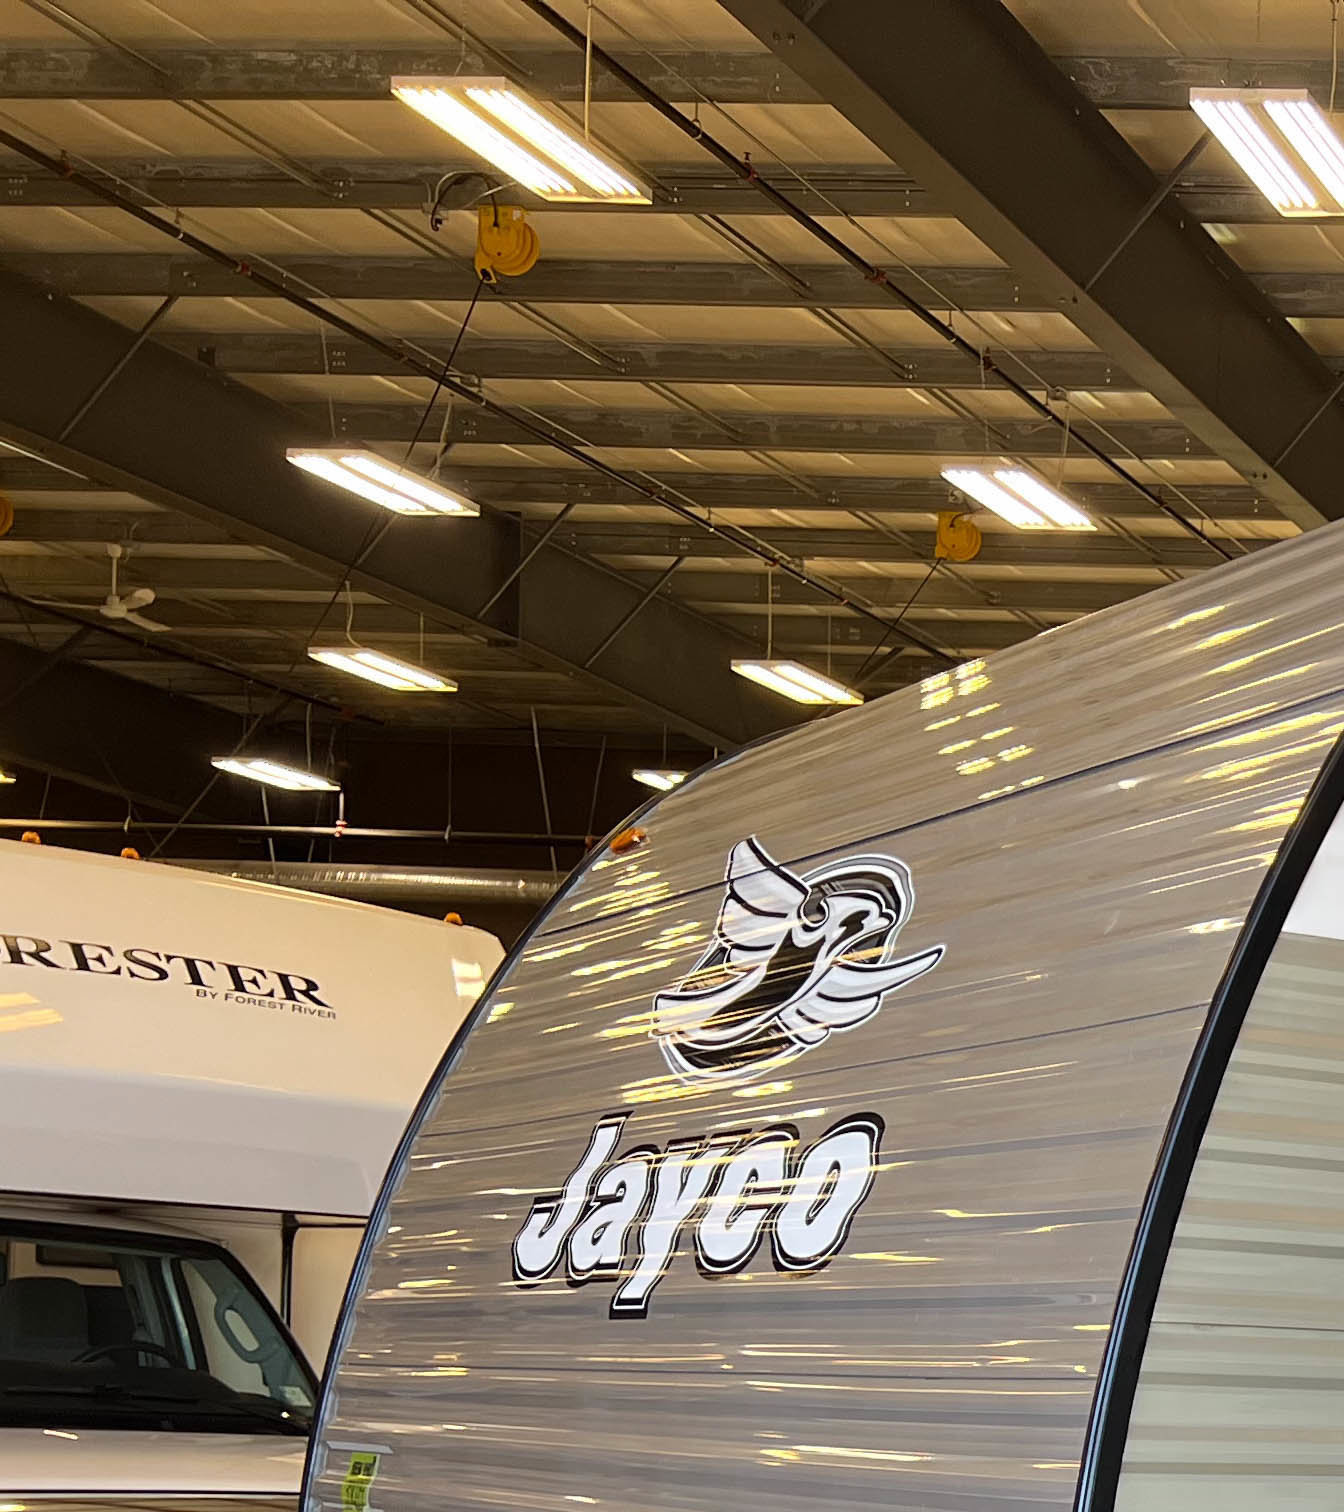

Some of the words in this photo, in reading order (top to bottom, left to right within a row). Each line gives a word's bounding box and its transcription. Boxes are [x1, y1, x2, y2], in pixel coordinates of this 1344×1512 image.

[0, 934, 334, 1010] RESTER
[224, 992, 287, 1011] FOREST
[291, 1004, 337, 1020] RIVER
[511, 1112, 885, 1319] Jayco
